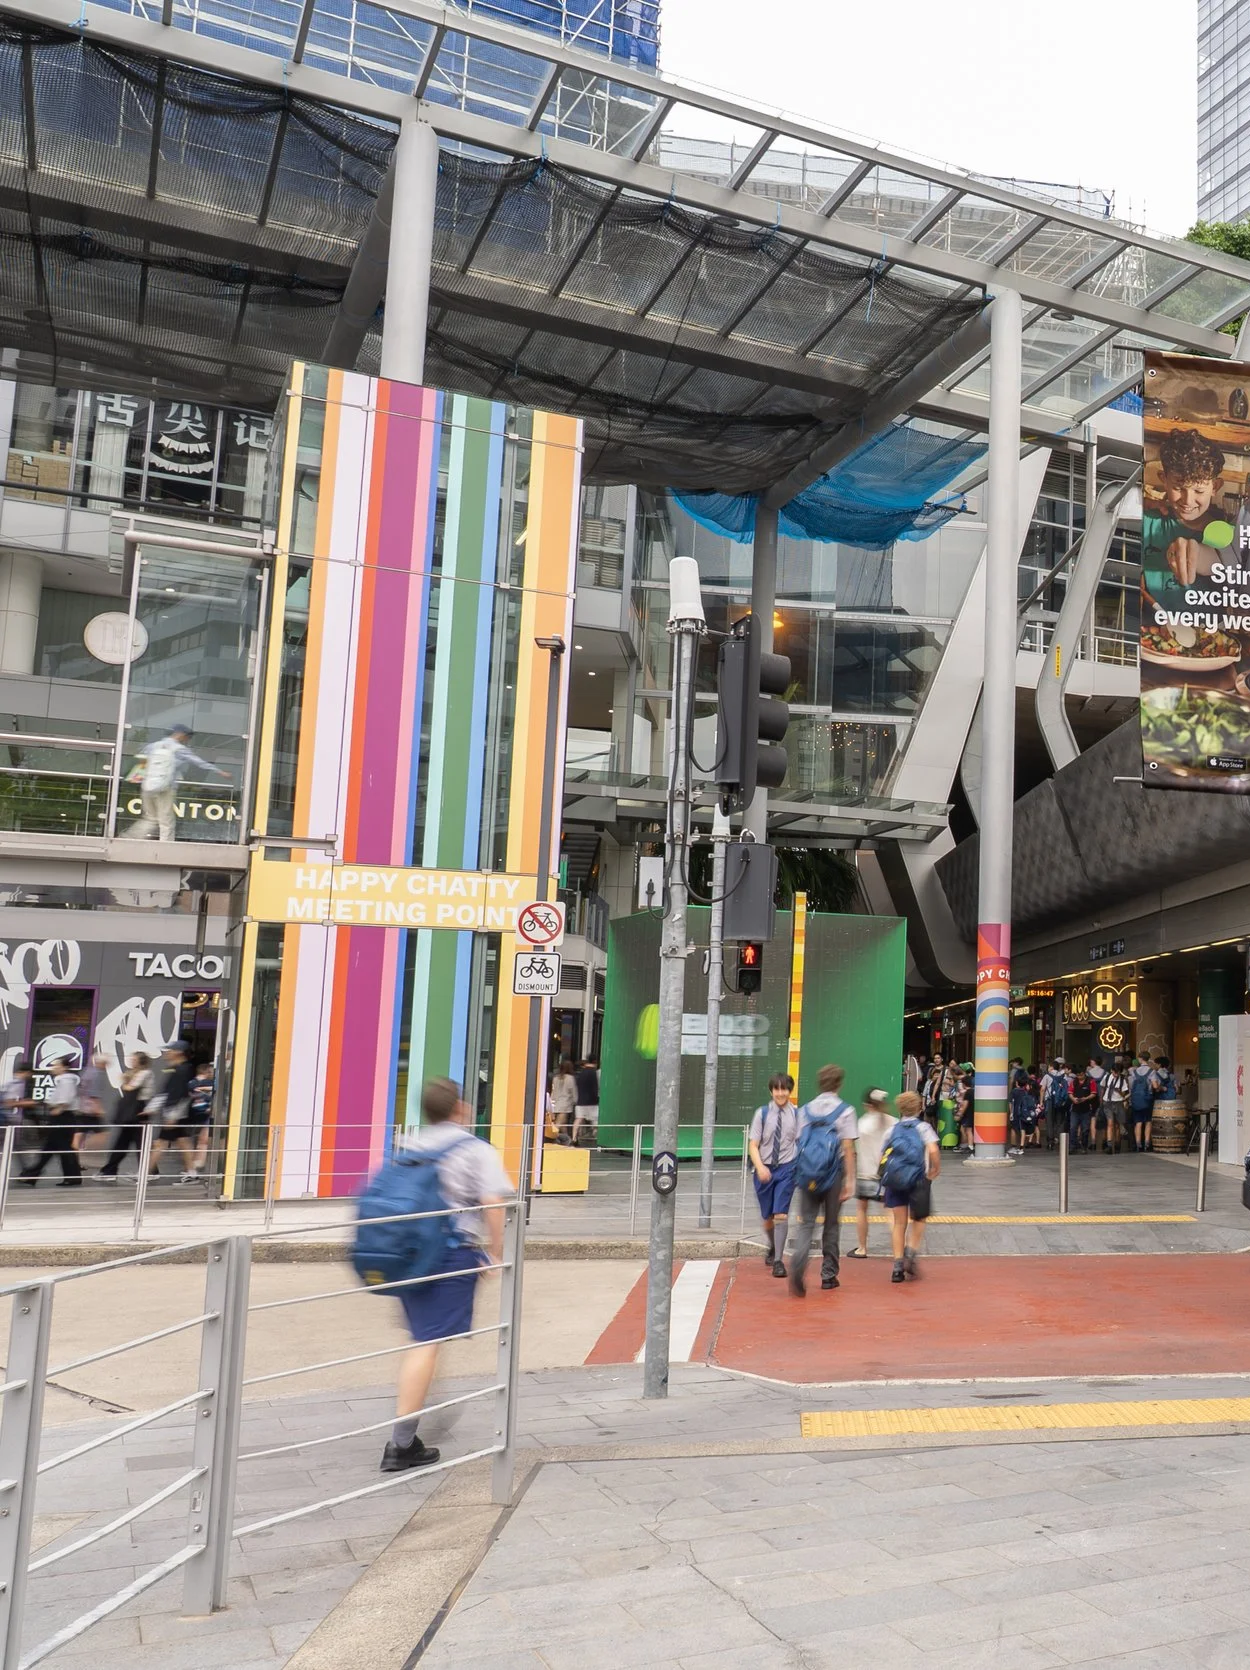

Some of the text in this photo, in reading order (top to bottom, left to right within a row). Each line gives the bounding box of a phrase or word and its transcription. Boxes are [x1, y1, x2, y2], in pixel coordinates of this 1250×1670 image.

[1154, 609, 1218, 634] every
[296, 868, 521, 899] HAPPY CHATTY
[287, 896, 427, 923] MEETING
[518, 983, 554, 991] DISMOUNT
